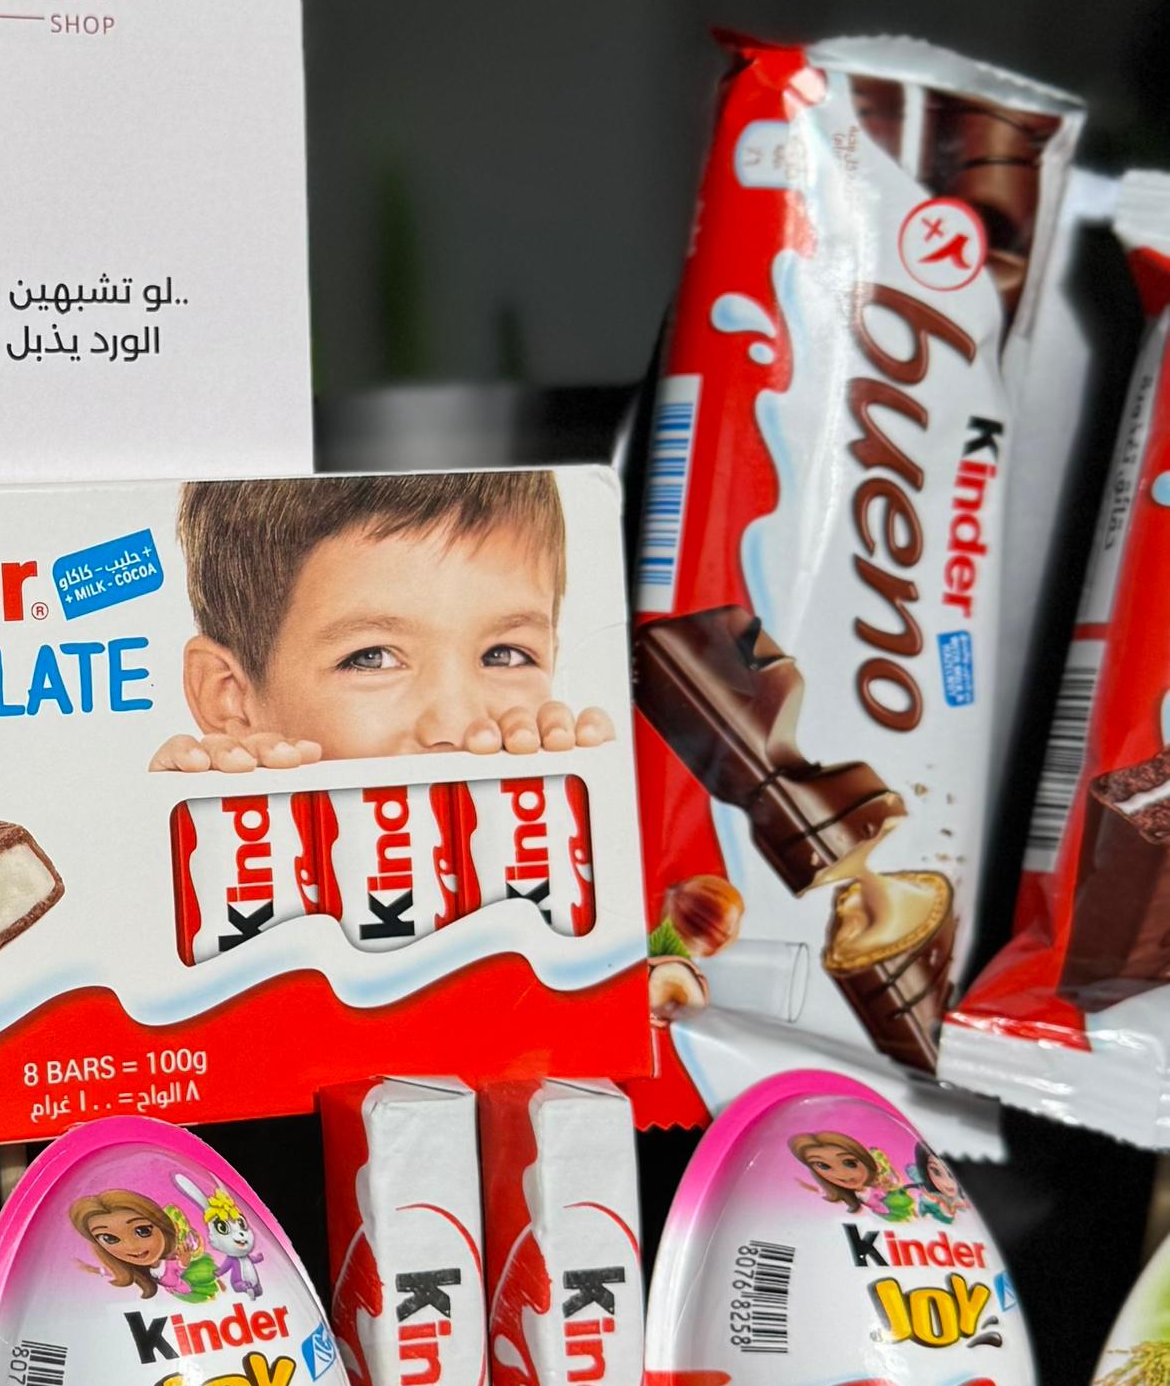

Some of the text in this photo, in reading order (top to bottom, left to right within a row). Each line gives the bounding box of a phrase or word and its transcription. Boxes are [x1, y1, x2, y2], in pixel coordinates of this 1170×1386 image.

[50, 15, 116, 35] SHOP
[8, 272, 133, 314] تشبهين
[6, 324, 79, 363] يذبل
[90, 326, 161, 361] الورد
[847, 282, 977, 731] bueno
[941, 415, 1004, 619] Kinder
[59, 563, 93, 591] كاكاو
[105, 550, 141, 573] حليب
[74, 579, 107, 601] MILK
[114, 562, 157, 587] COCOA
[23, 1062, 39, 1087] 8
[46, 1055, 116, 1085] BARS
[146, 1048, 207, 1075] 100g
[30, 1093, 72, 1124] غرام
[136, 1082, 181, 1113] الواح
[185, 1079, 201, 1102] ٨
[842, 1222, 987, 1269] Kinder
[730, 1245, 759, 1346] 8076 8258
[123, 1303, 292, 1365] Kinder
